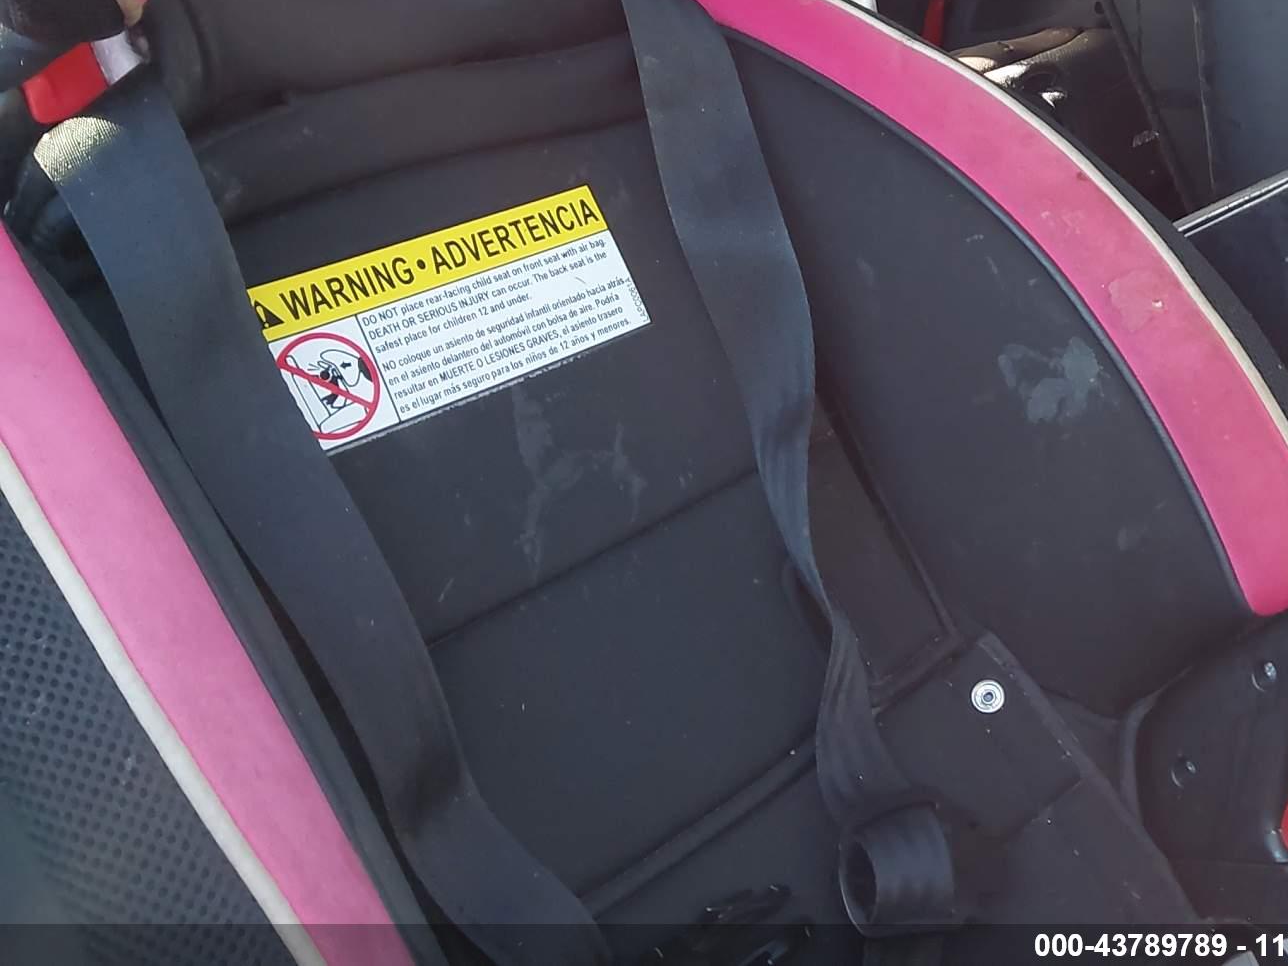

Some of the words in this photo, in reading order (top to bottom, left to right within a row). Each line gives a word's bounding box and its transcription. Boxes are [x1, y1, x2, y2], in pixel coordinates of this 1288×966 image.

[278, 256, 414, 321] WARNING
[431, 198, 599, 274] ADVERTENCIA
[361, 313, 378, 327] DO
[377, 305, 399, 323] NOT
[400, 300, 425, 317] place
[425, 284, 472, 307] rear-facing
[471, 274, 493, 290] child
[492, 269, 512, 283] seat
[511, 266, 524, 277] on
[522, 258, 544, 273] front
[542, 252, 561, 266] seat
[560, 246, 578, 259] with
[578, 242, 589, 254] air
[367, 321, 402, 341] DEATH
[401, 315, 418, 329] OR
[416, 301, 459, 324] SERIOUS
[457, 290, 490, 310] INJURY
[491, 287, 508, 298] can
[531, 272, 549, 283] The
[547, 263, 569, 278] back
[568, 257, 587, 271] seat
[584, 255, 595, 265] is
[593, 251, 608, 262] the
[374, 336, 404, 354] safest
[403, 329, 429, 346] place
[427, 324, 441, 336] for
[442, 312, 478, 330] children
[477, 305, 490, 317] 12
[489, 299, 506, 314] and
[381, 359, 397, 373] NO
[397, 348, 432, 367] coloque
[432, 344, 445, 355] un
[444, 333, 475, 351] asiento
[474, 328, 486, 339] de
[485, 312, 526, 335] seguridad
[523, 302, 552, 321] infantil
[551, 291, 587, 311] orientado
[584, 283, 607, 298] hacia
[606, 275, 625, 290] atrás
[388, 376, 401, 387] en
[400, 370, 410, 382] el
[409, 361, 441, 379] asiento
[441, 346, 480, 367] delantero
[479, 338, 494, 352] del
[493, 324, 532, 347] automóvil
[531, 321, 548, 333] con
[545, 313, 569, 327] bolsa
[567, 308, 579, 319] de
[594, 292, 621, 309] Podría
[393, 381, 427, 401] resultar
[427, 377, 440, 388] en
[438, 360, 477, 383] MUERTE
[475, 357, 484, 369] O
[483, 341, 526, 366] LESIONES
[561, 324, 571, 336] el
[569, 316, 598, 333] asiento
[596, 306, 624, 322] trasero
[399, 403, 411, 414] es
[411, 397, 421, 410] el
[419, 390, 443, 407] lugar
[442, 382, 462, 397] más
[461, 372, 491, 390] seguro
[490, 365, 511, 381] para
[509, 359, 524, 371] los
[524, 350, 548, 365] niños
[548, 345, 559, 356] de
[559, 339, 571, 351] 12
[570, 333, 590, 347] años
[589, 330, 596, 342] y
